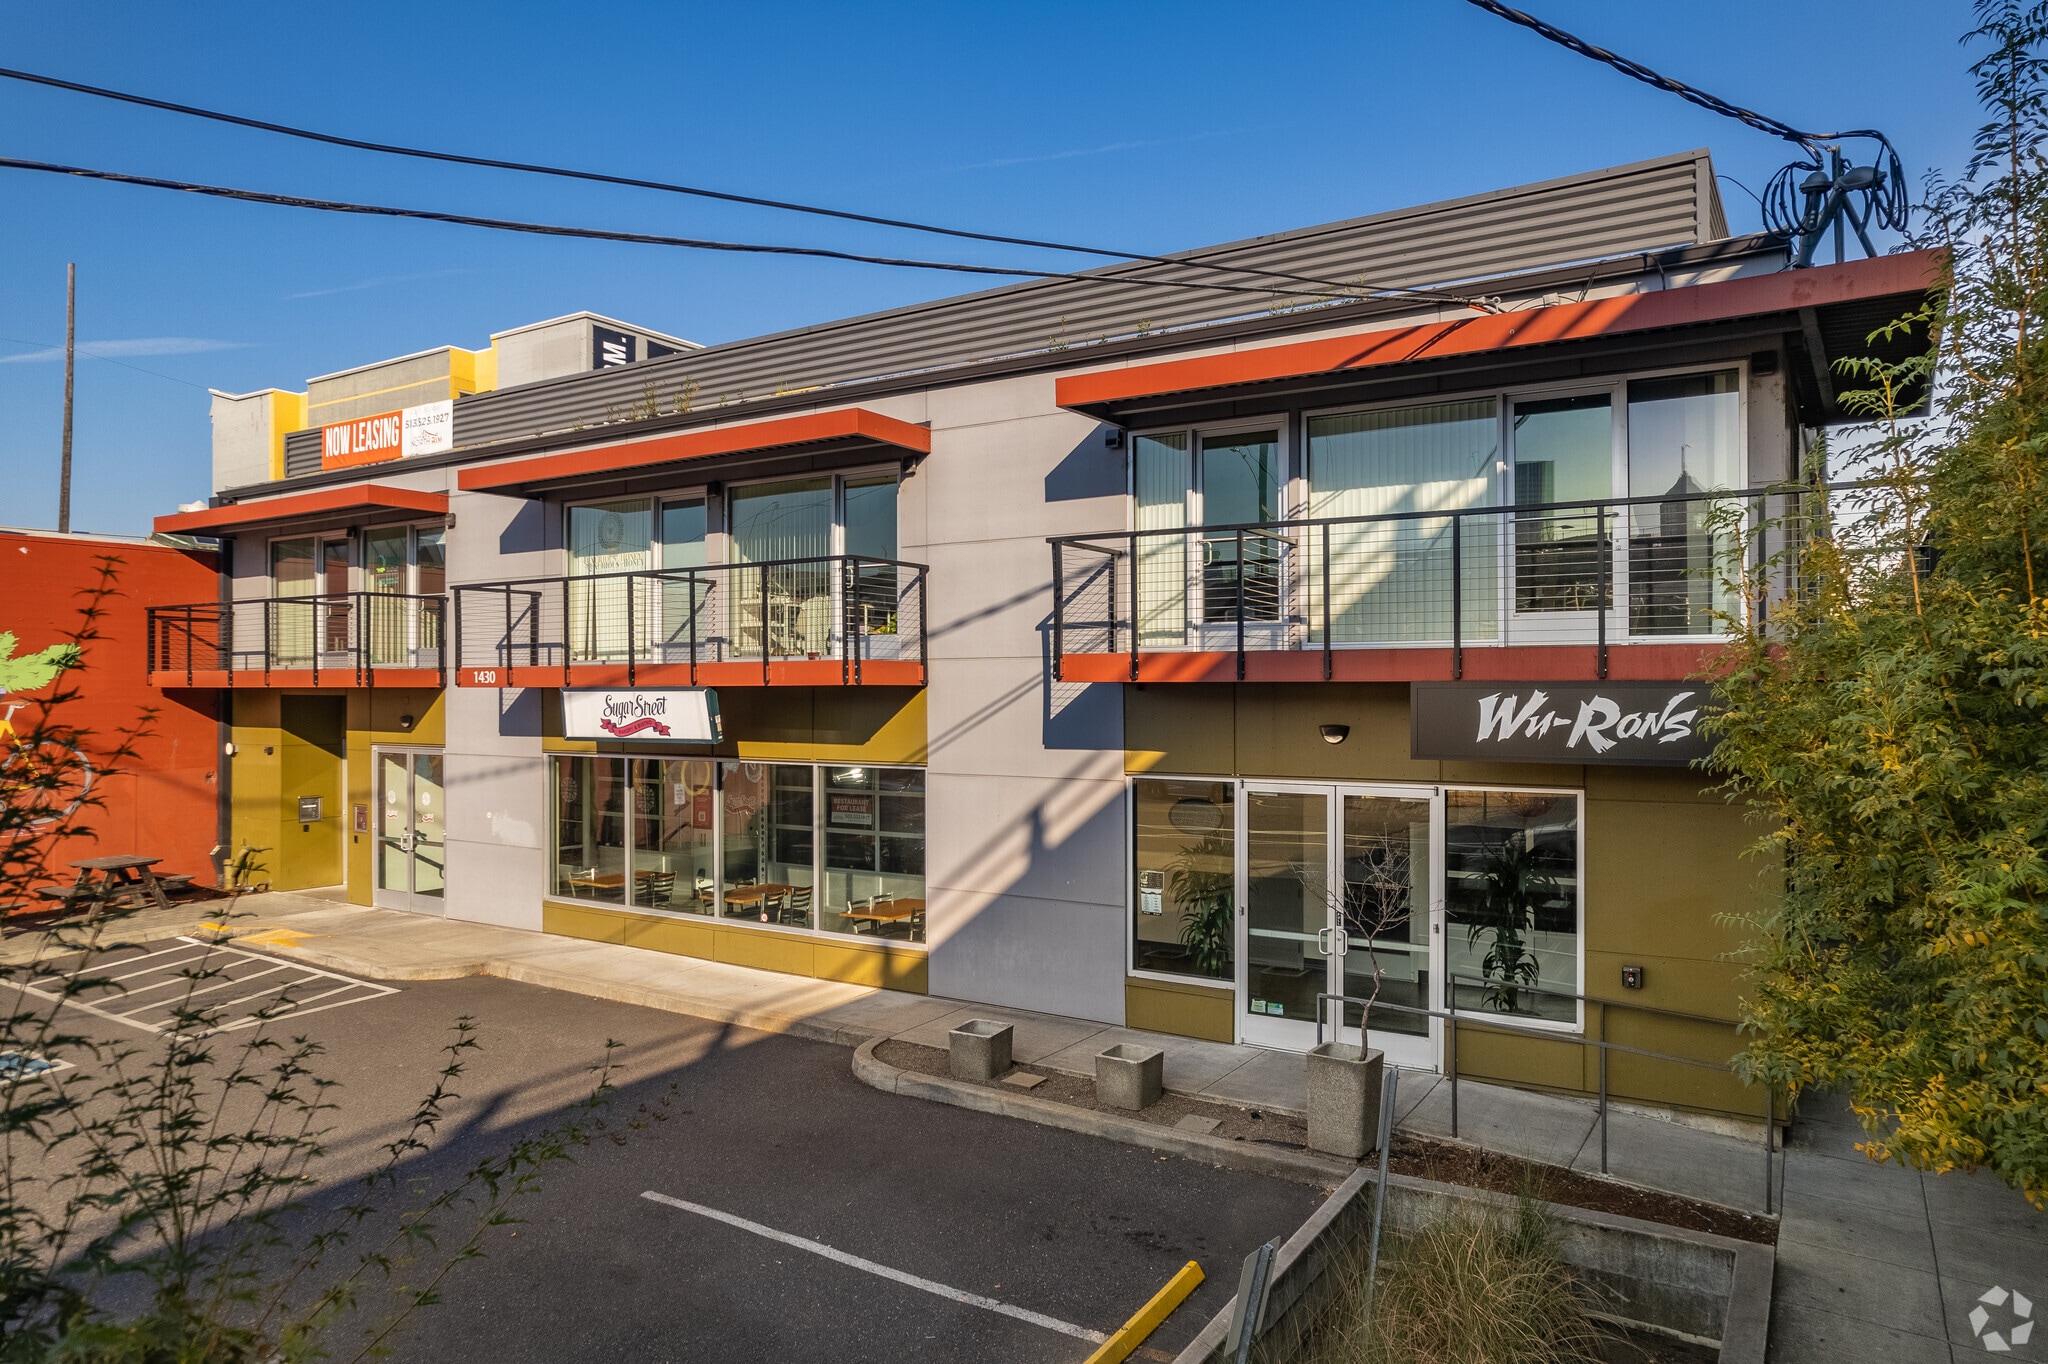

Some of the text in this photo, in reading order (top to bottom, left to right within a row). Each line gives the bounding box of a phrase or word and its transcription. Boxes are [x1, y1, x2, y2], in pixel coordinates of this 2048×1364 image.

[325, 415, 400, 458] NOW LEASING
[473, 670, 496, 684] 1430
[603, 694, 668, 725] Sugar Street
[833, 798, 869, 806] RESTAURANT
